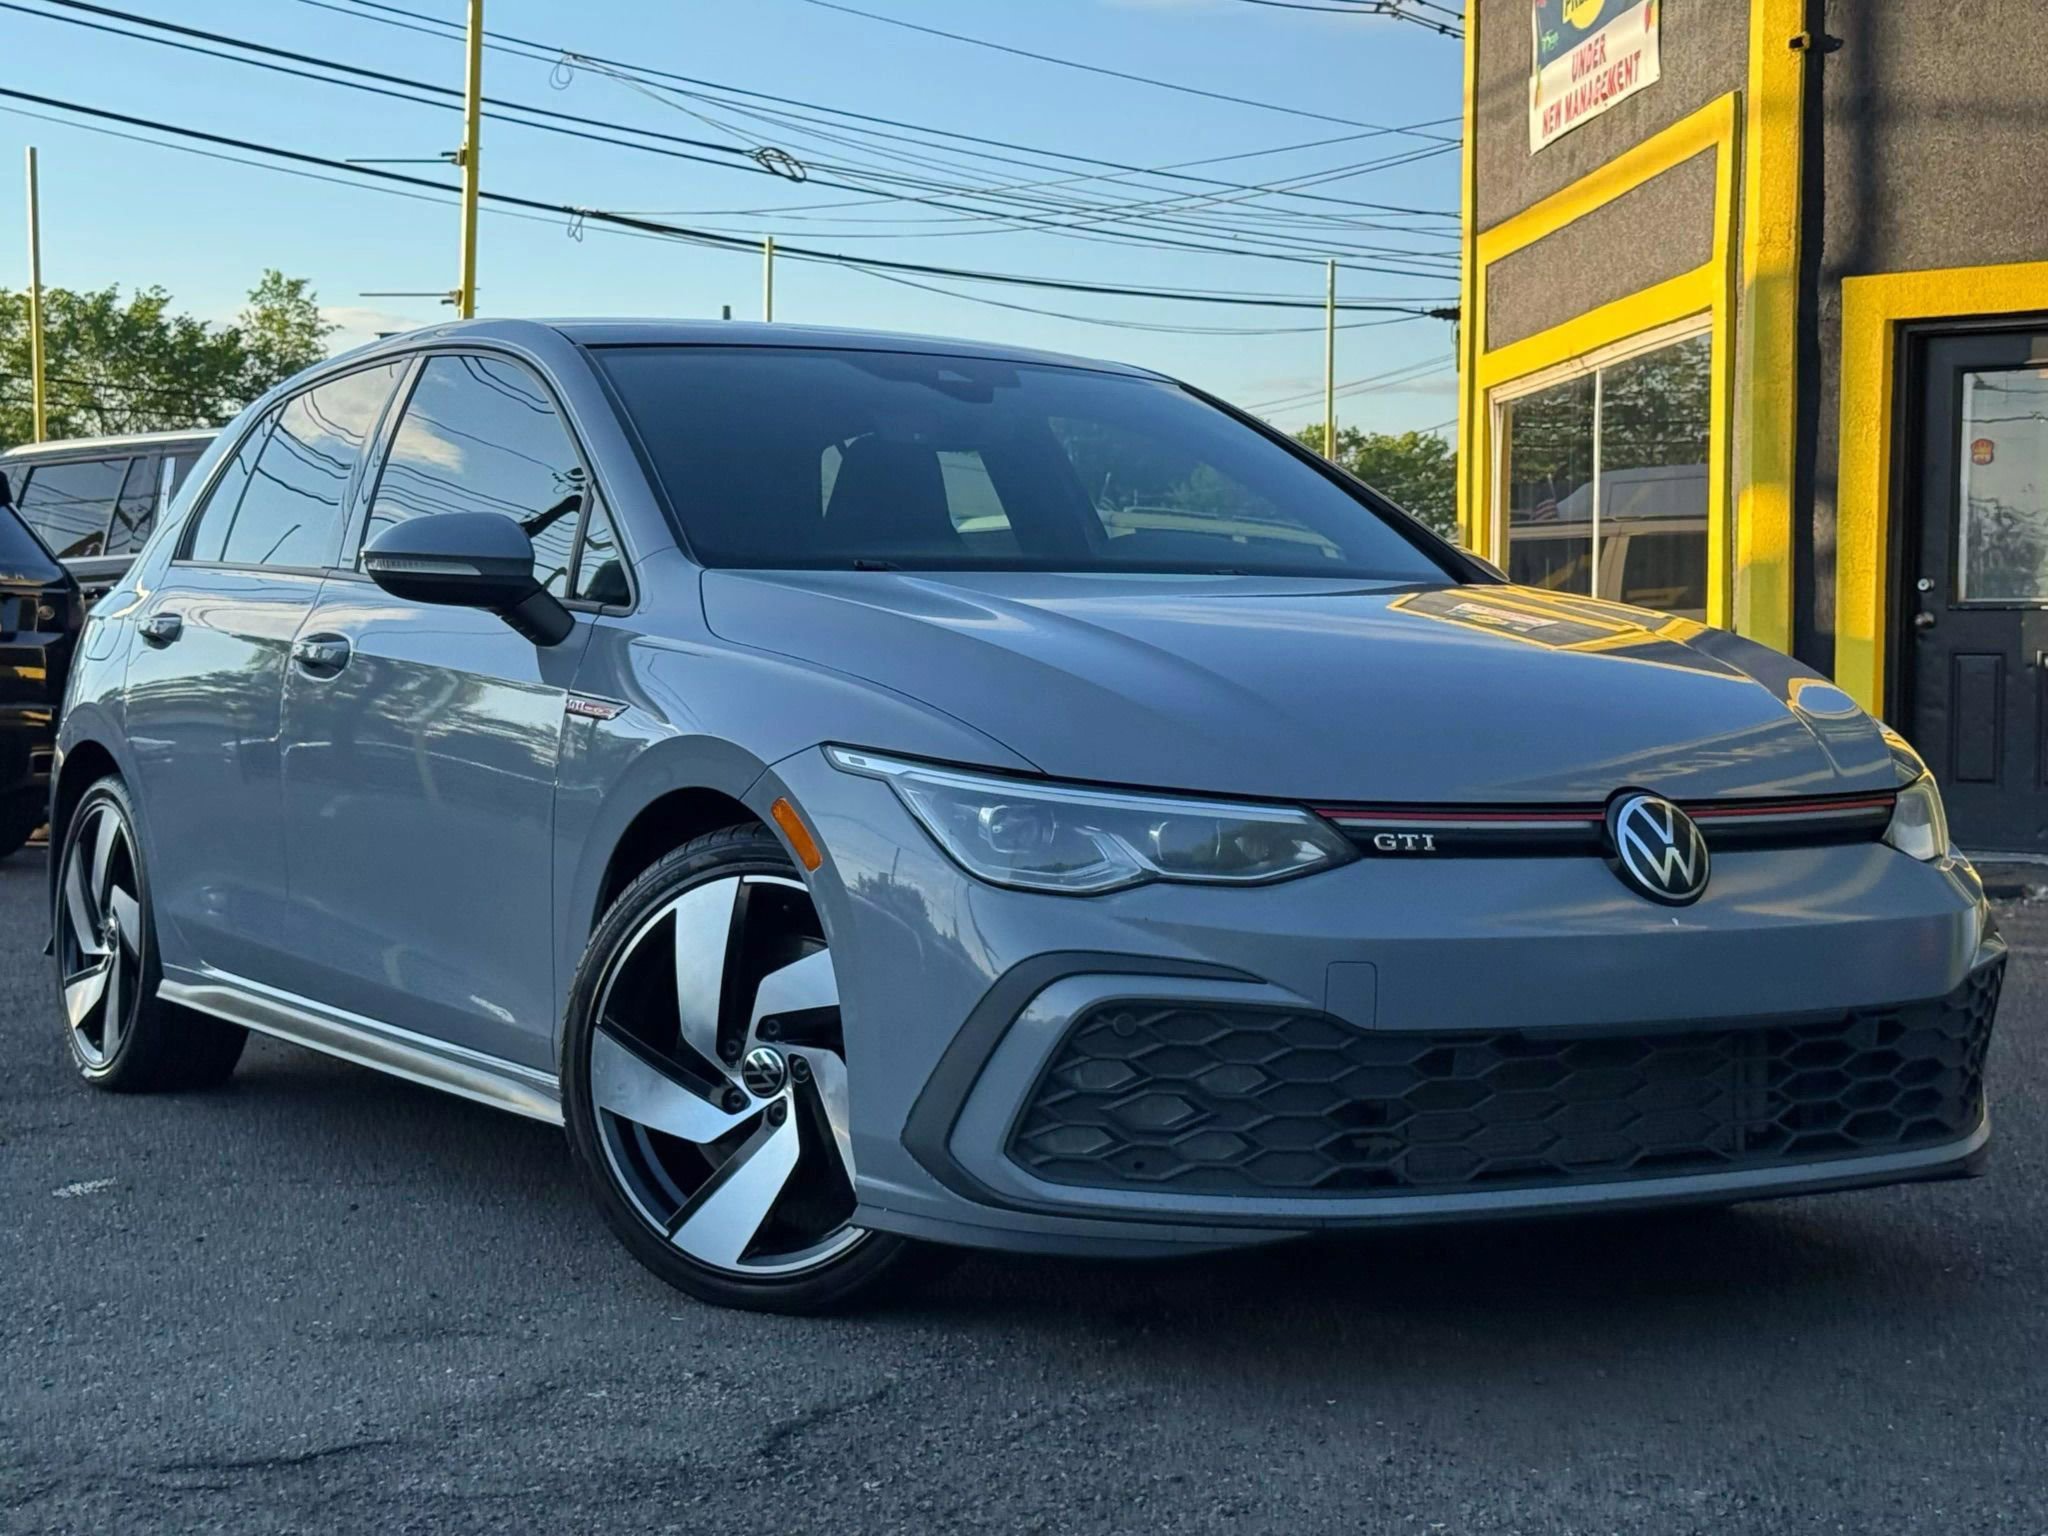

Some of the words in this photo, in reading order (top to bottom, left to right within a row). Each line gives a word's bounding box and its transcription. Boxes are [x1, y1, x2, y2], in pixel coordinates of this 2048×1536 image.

[1571, 33, 1606, 83] UNDER
[1542, 99, 1562, 139] NEW
[1564, 49, 1641, 124] MANAGEMENT
[1373, 832, 1436, 851] GTI
